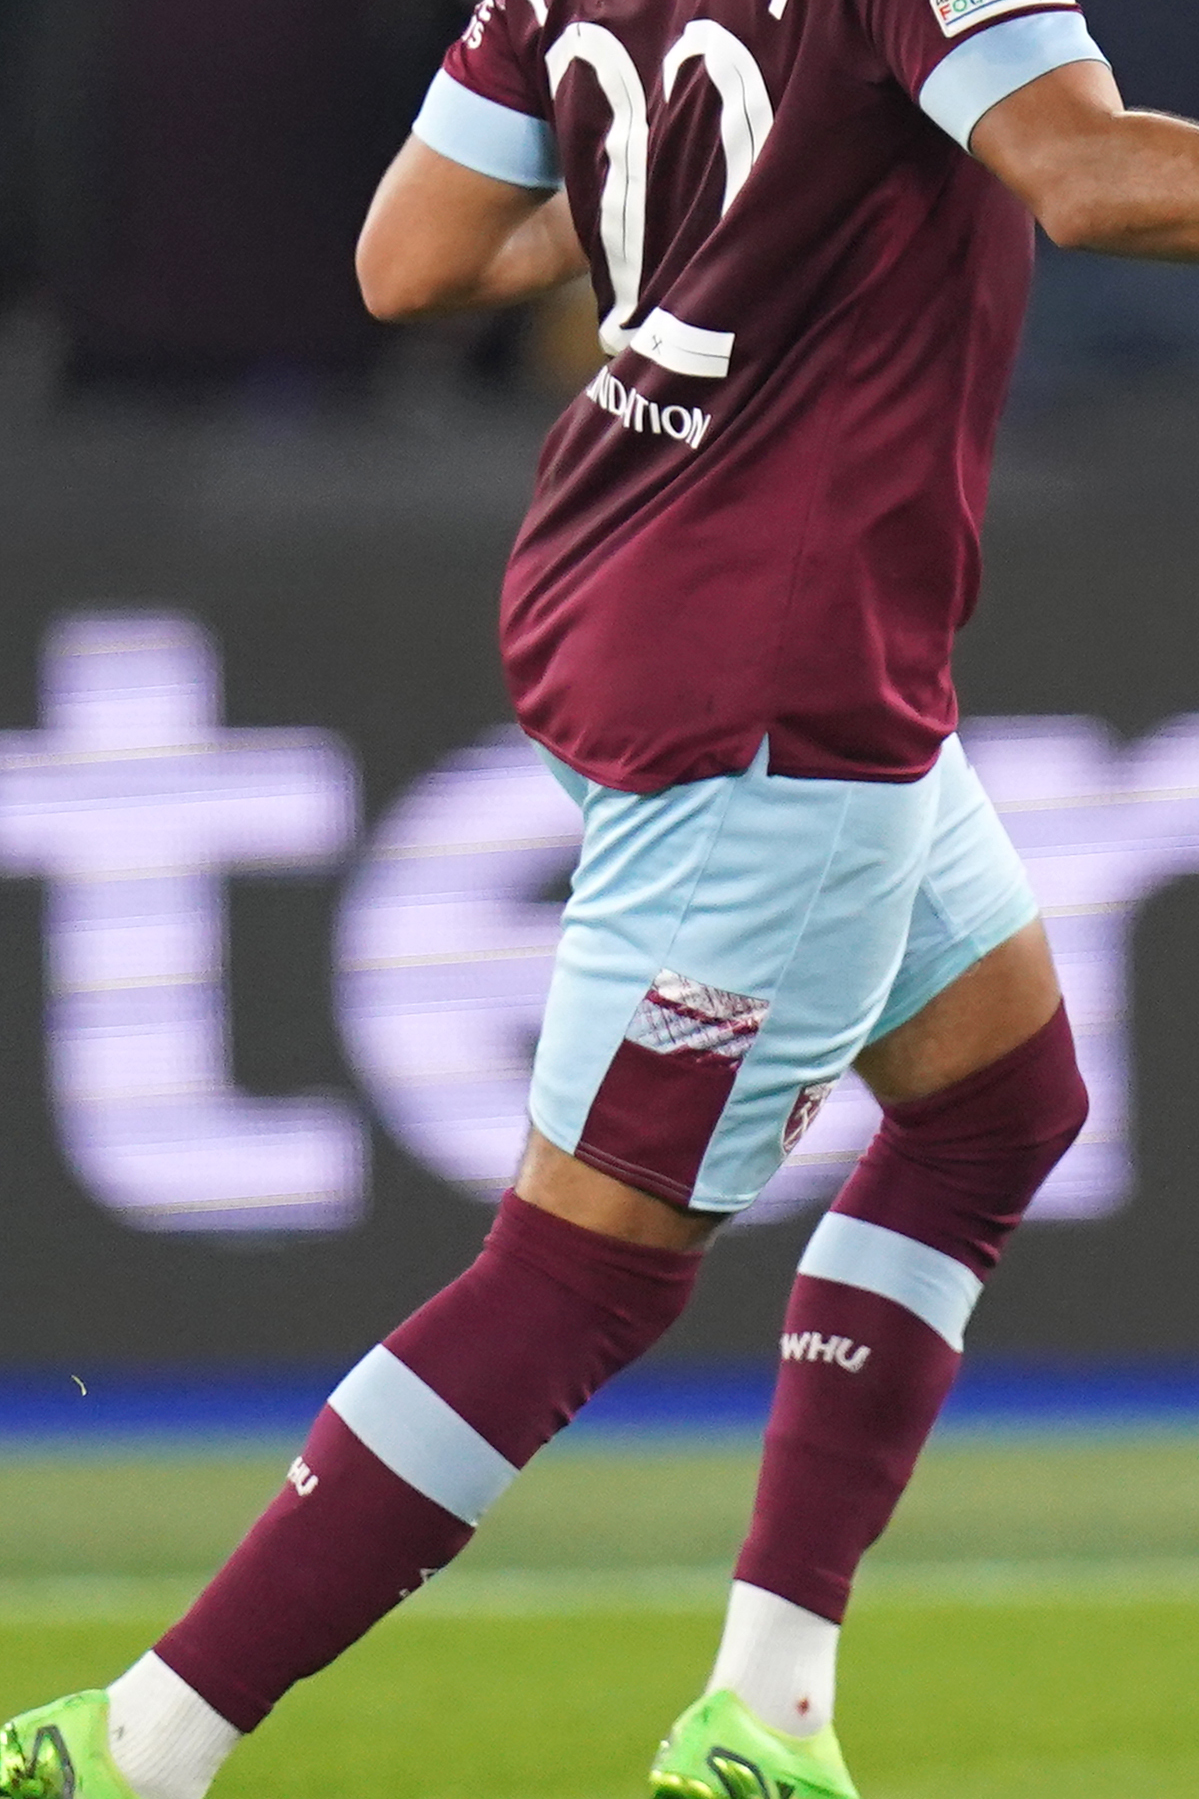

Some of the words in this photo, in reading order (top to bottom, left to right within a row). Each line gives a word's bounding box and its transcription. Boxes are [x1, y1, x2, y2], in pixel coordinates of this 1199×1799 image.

[544, 20, 775, 378] 22
[780, 1331, 872, 1373] WHU
[287, 1456, 319, 1497] HU
